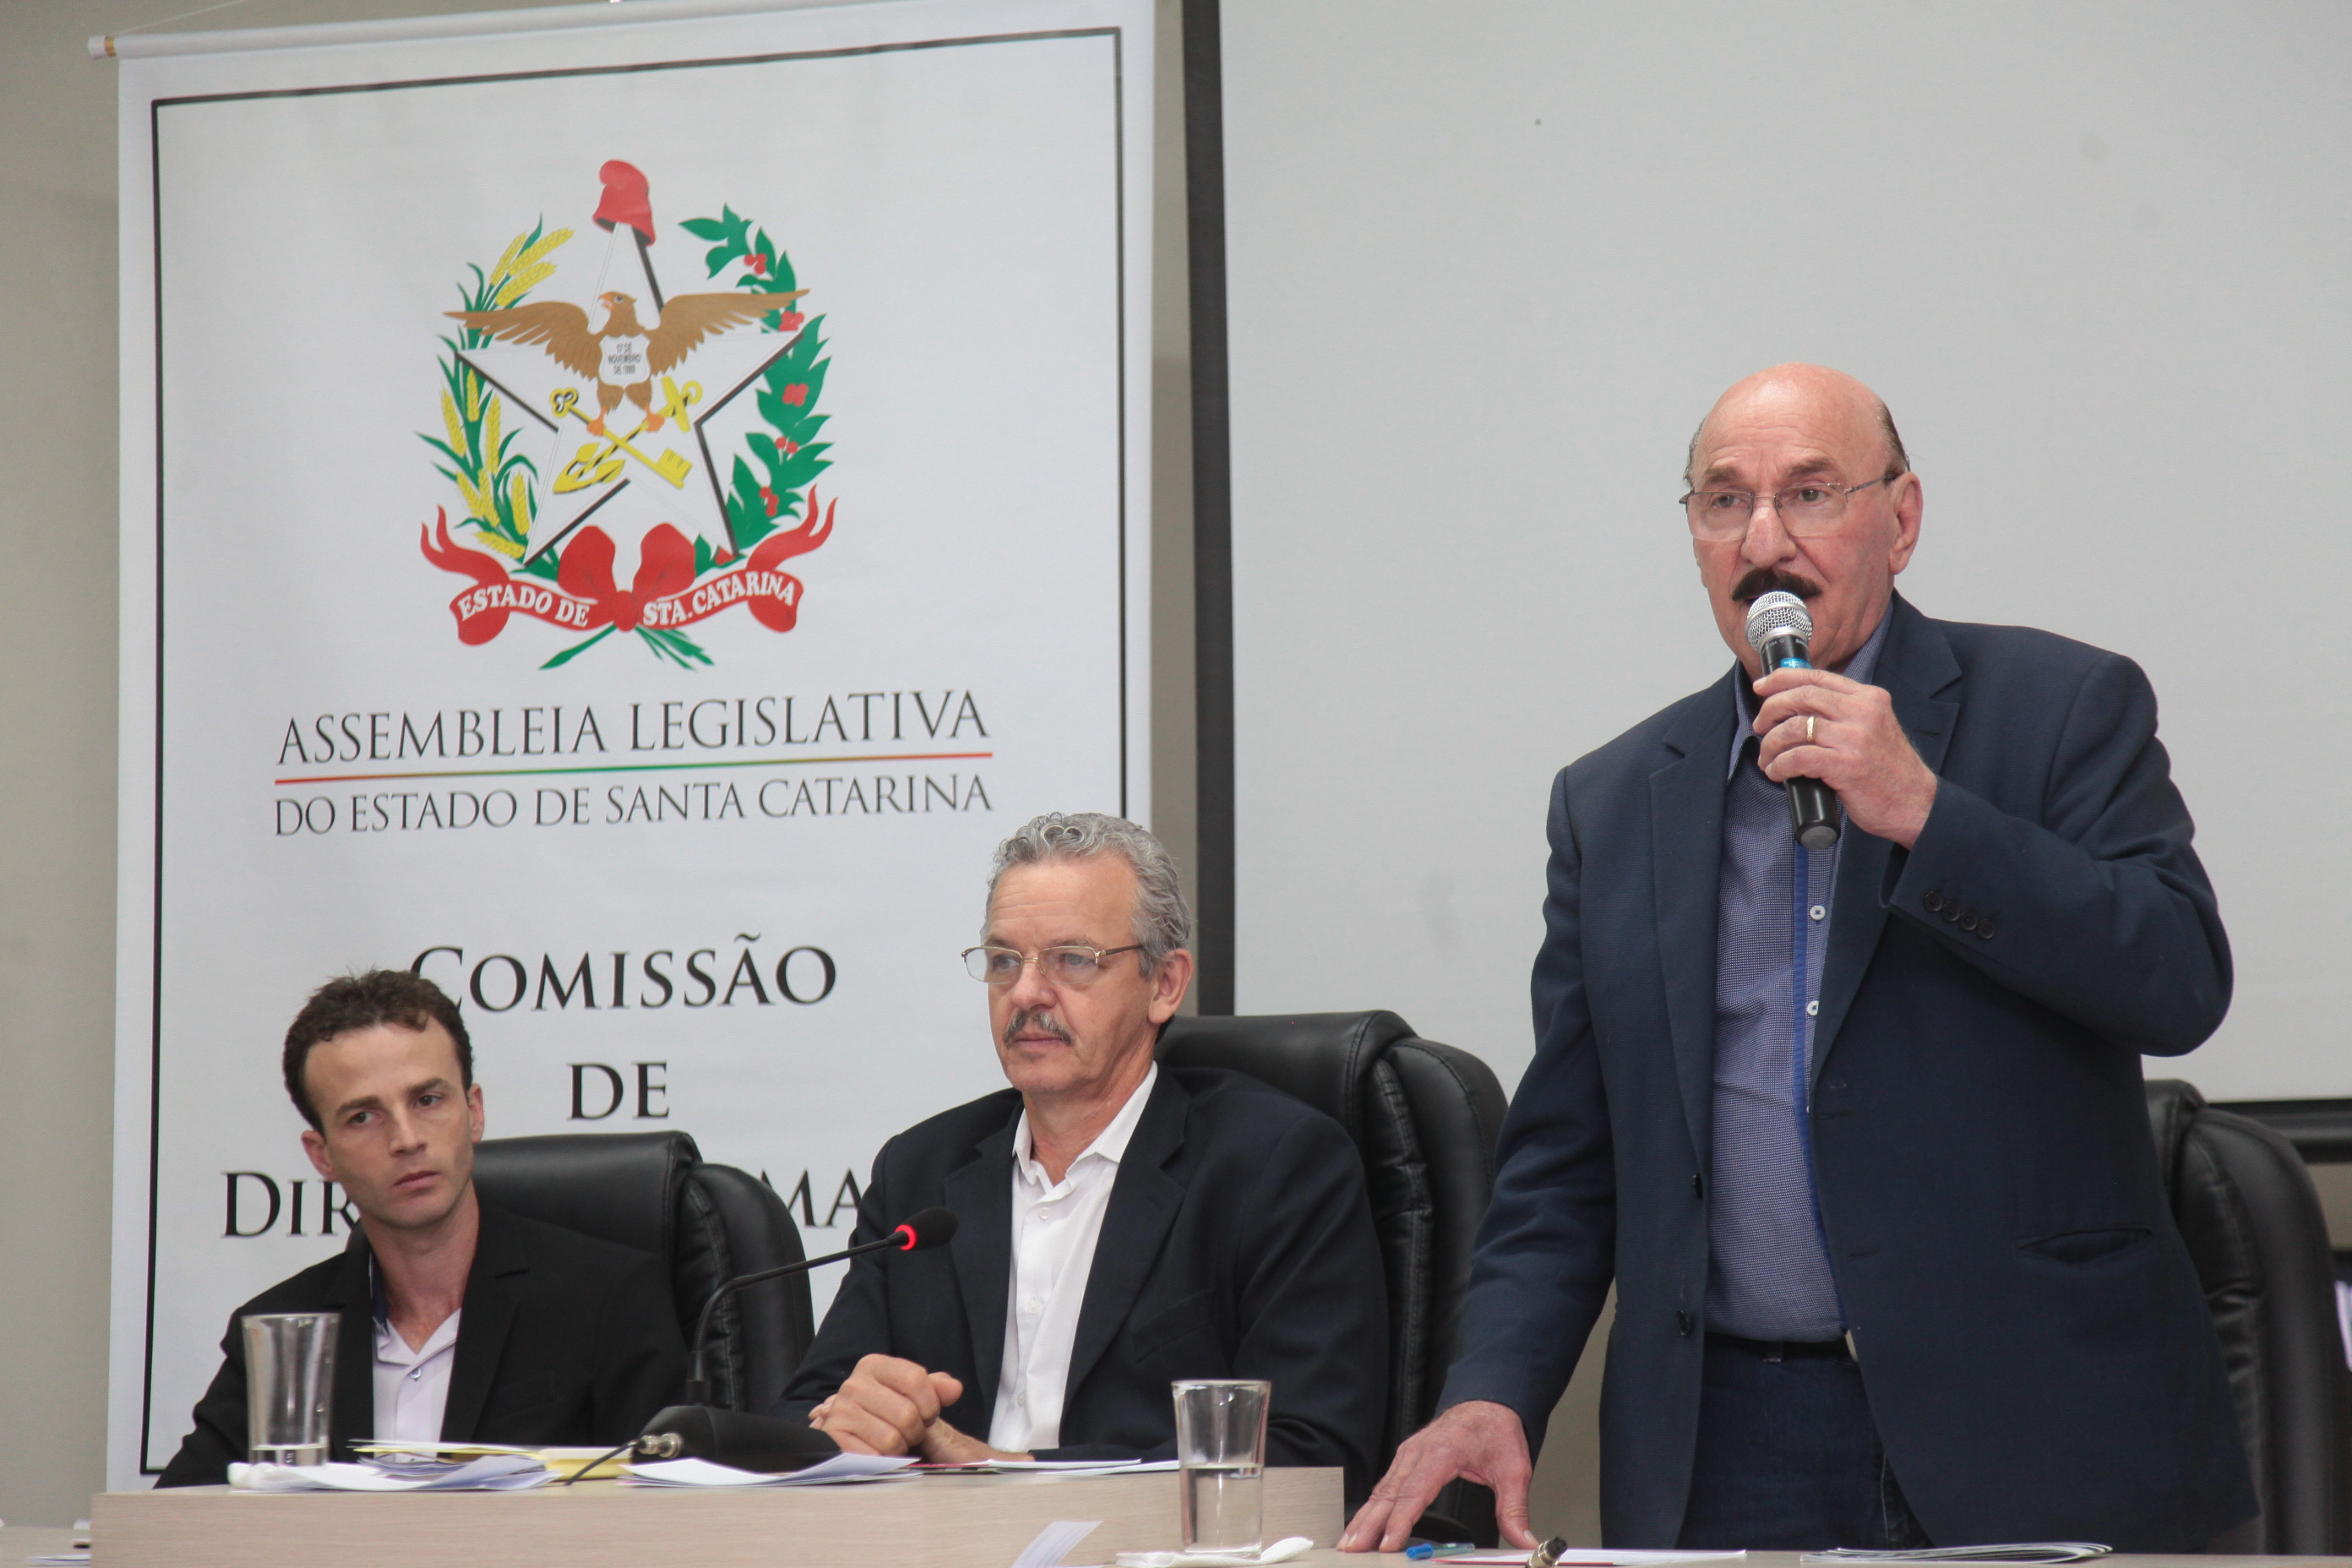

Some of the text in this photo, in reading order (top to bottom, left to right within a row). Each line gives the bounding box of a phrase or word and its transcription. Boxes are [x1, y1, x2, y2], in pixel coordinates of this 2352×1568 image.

[457, 584, 553, 622] ESTADO
[554, 600, 591, 628] DE
[276, 689, 990, 765] ASSEMBLEIA LEGISLATIVA
[275, 773, 994, 836] DO ESTADO DE SANTA CATARINA
[567, 1060, 670, 1121] DE
